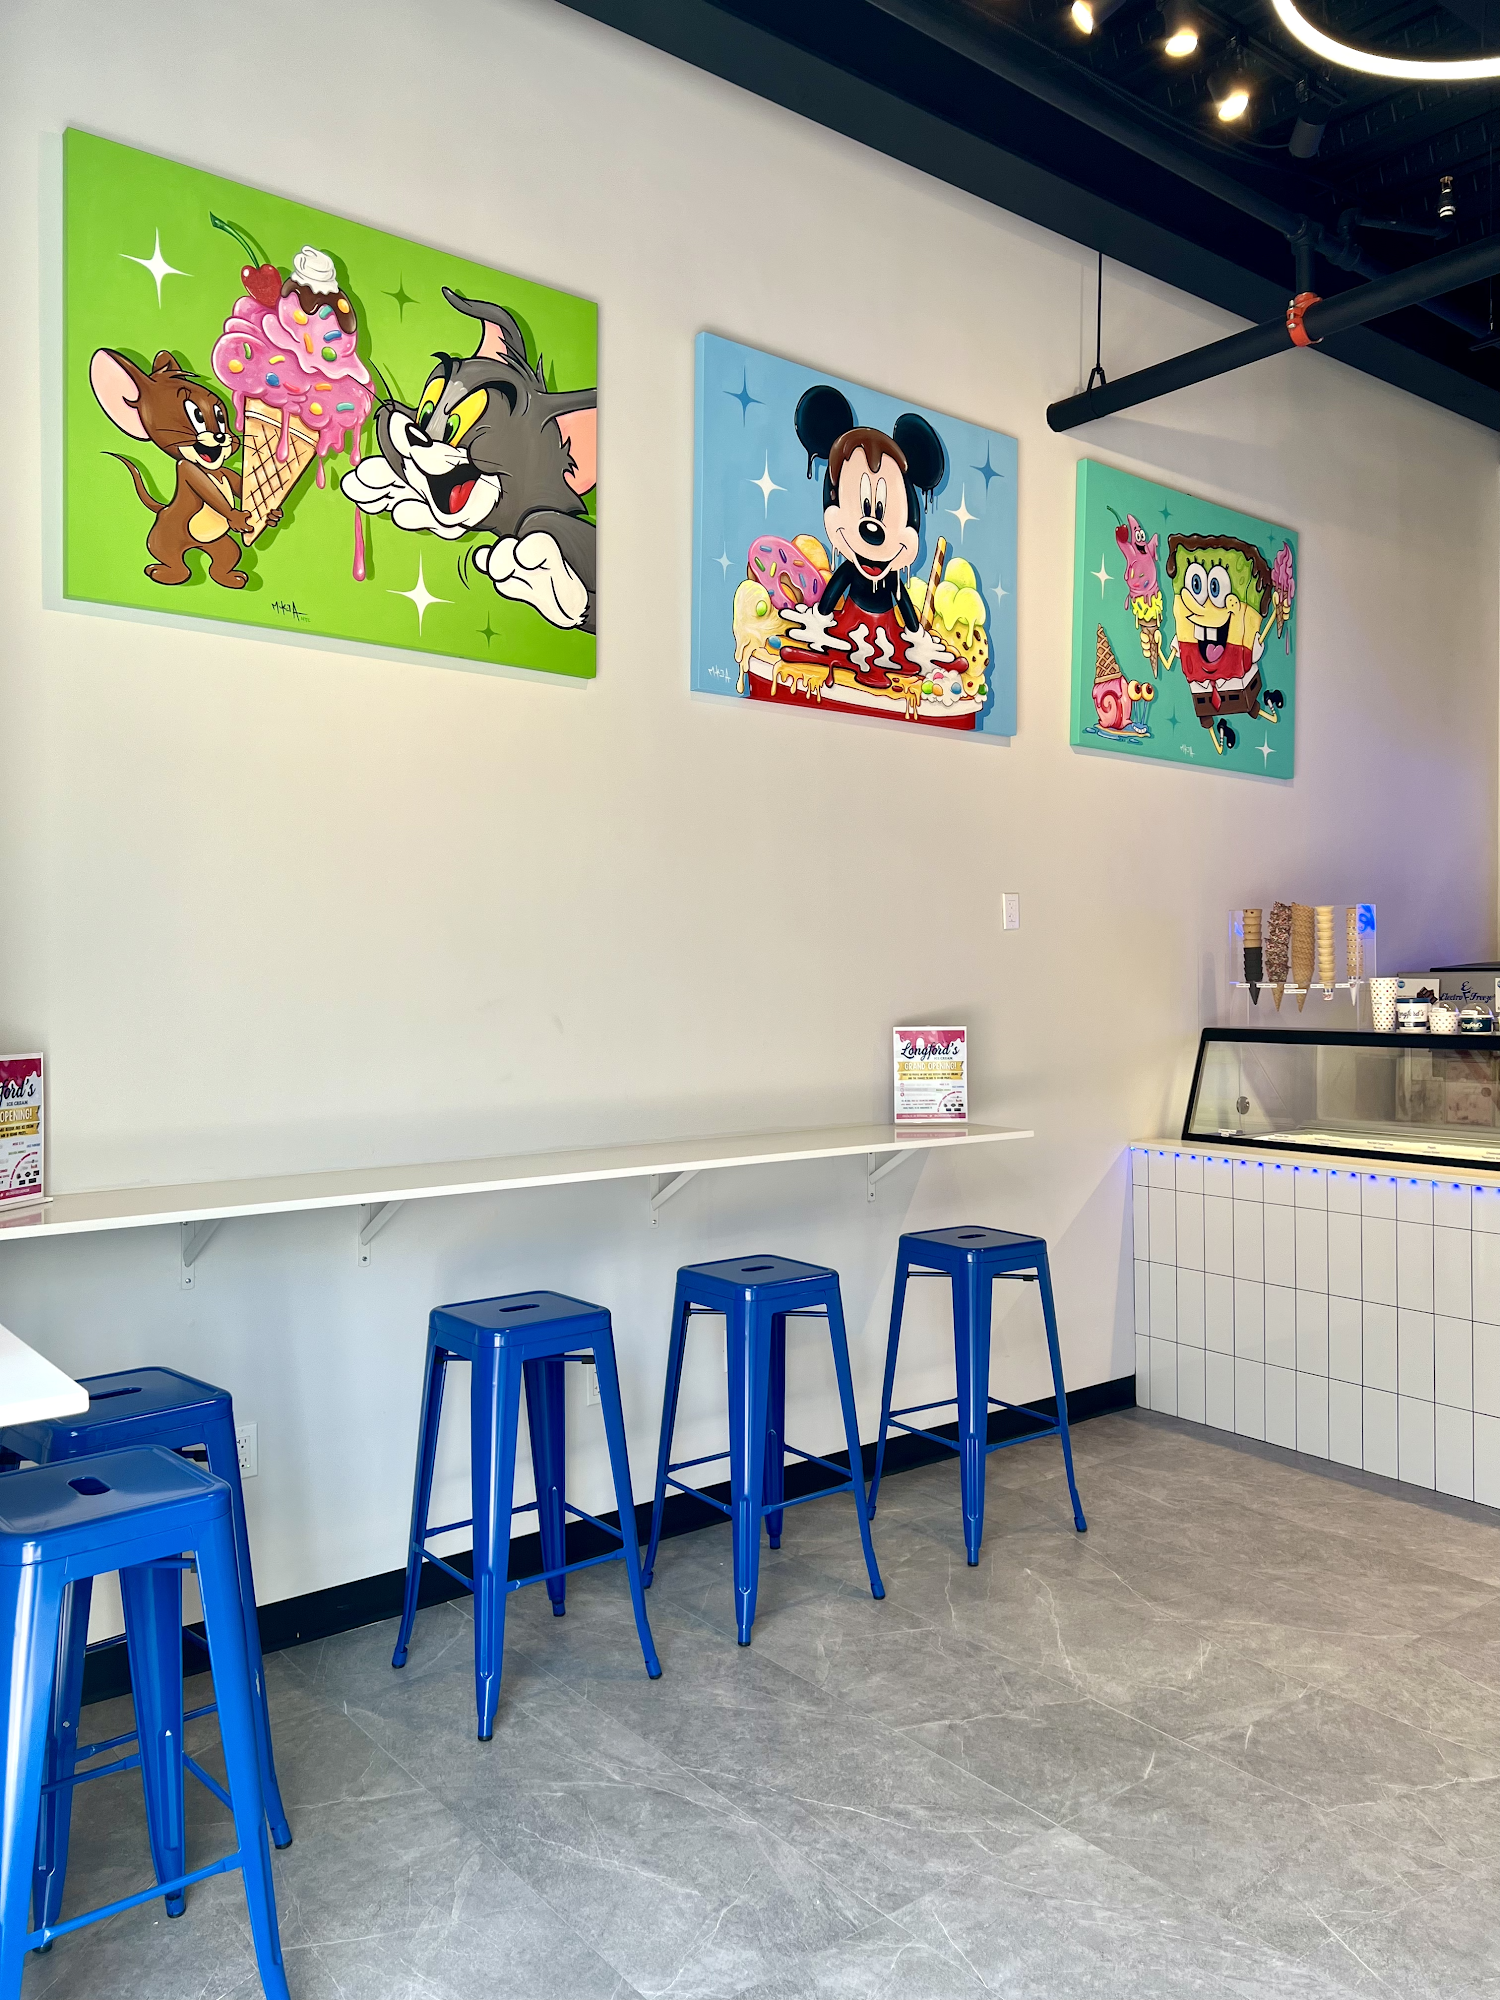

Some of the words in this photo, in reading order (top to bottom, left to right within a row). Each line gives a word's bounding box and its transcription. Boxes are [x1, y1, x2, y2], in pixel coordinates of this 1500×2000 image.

[1439, 992, 1463, 1001] Electro
[901, 1042, 960, 1061] Longford's
[904, 1061, 925, 1071] GRAND
[927, 1061, 957, 1070] OPENING!
[0, 1078, 36, 1107] ford's
[0, 1108, 32, 1123] OPENING!
